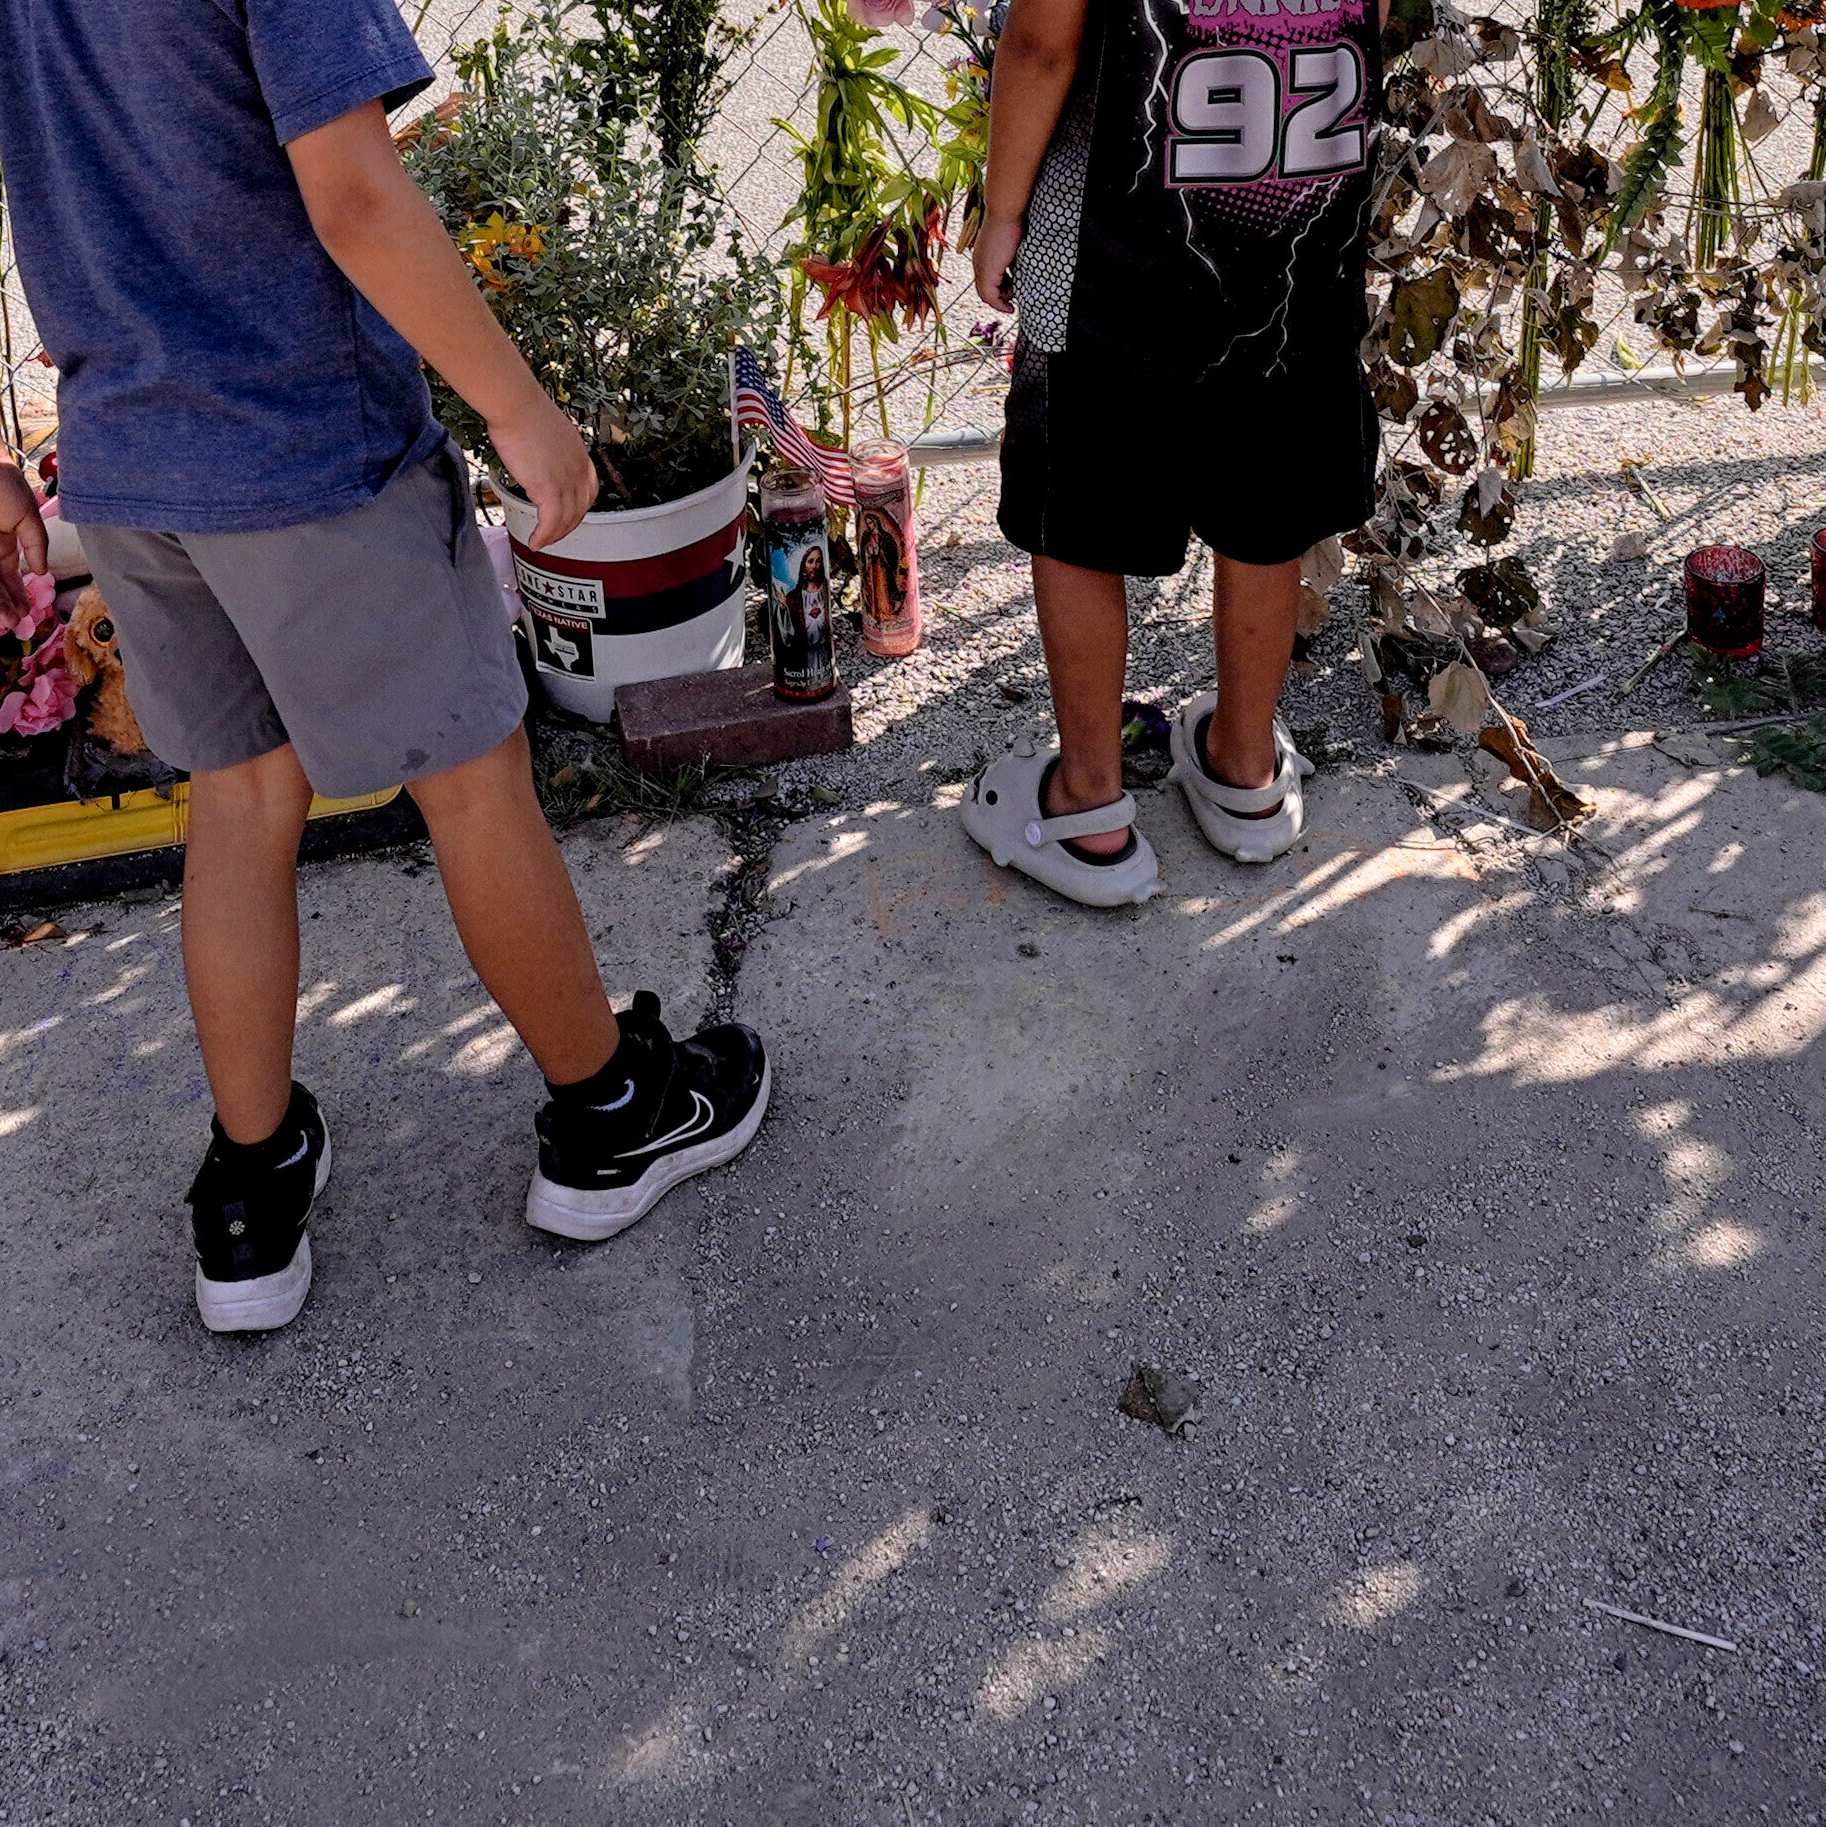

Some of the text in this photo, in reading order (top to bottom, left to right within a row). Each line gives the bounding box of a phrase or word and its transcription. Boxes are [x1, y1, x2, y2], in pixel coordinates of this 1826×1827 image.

[1166, 42, 1368, 188] 92
[557, 585, 597, 603] STAR
[554, 615, 588, 630] NATIVE
